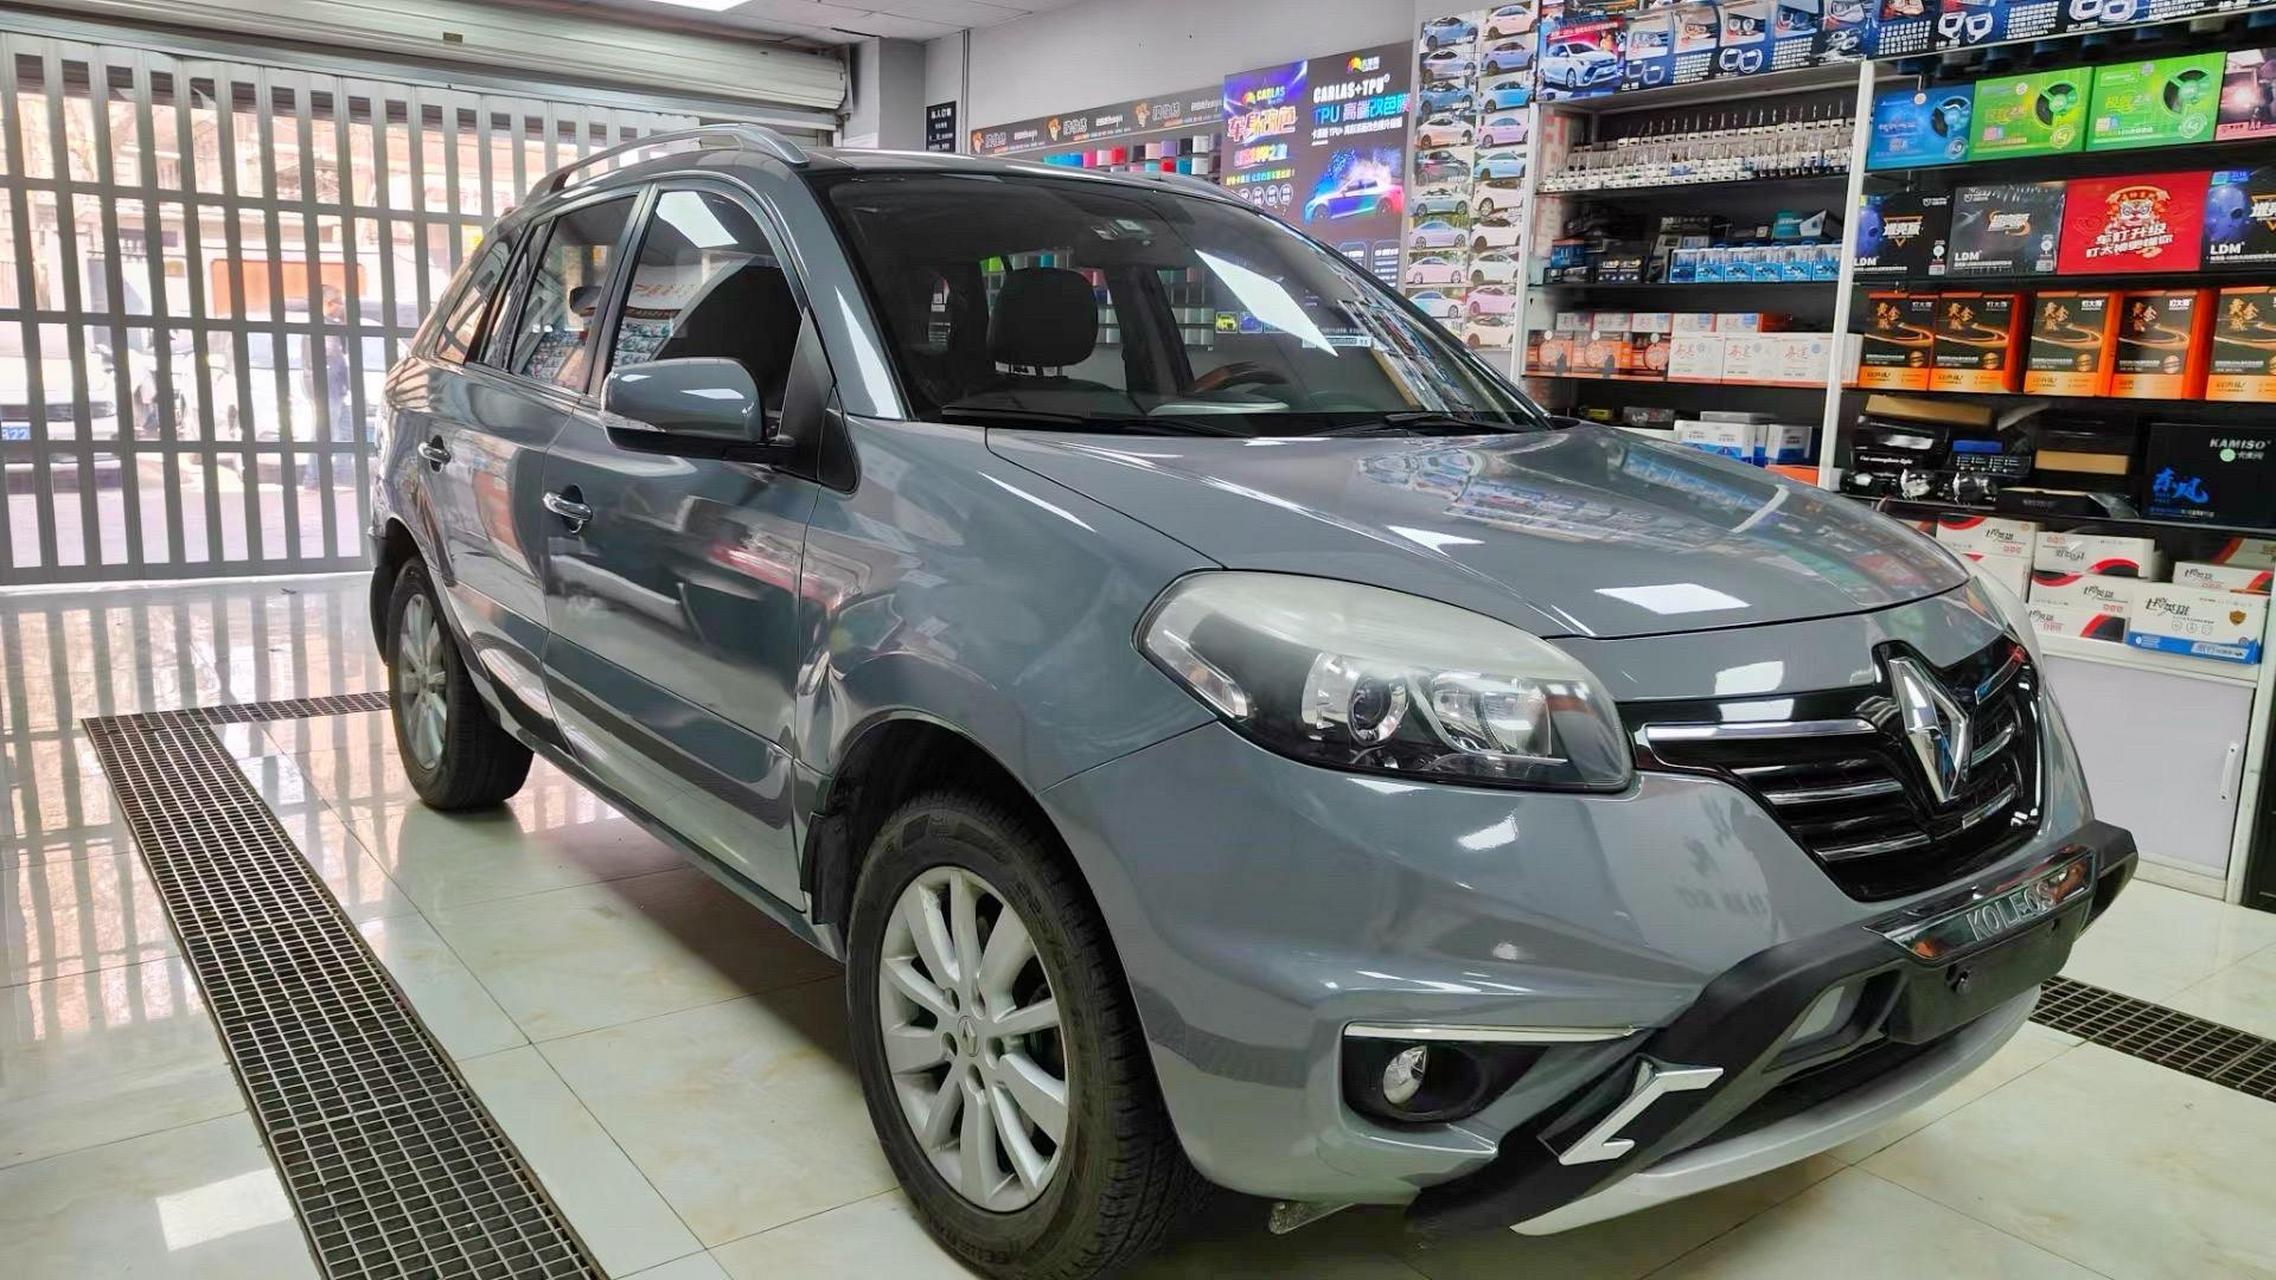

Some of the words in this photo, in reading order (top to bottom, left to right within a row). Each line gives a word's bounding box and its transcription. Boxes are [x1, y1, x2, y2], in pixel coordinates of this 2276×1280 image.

[1312, 104, 1340, 125] TPU
[2209, 243, 2242, 255] LDM
[1853, 256, 1877, 266] LDM
[1954, 251, 1980, 262] LDM
[2209, 438, 2267, 450] KAMISO
[1966, 881, 2057, 941] KOLEOS
